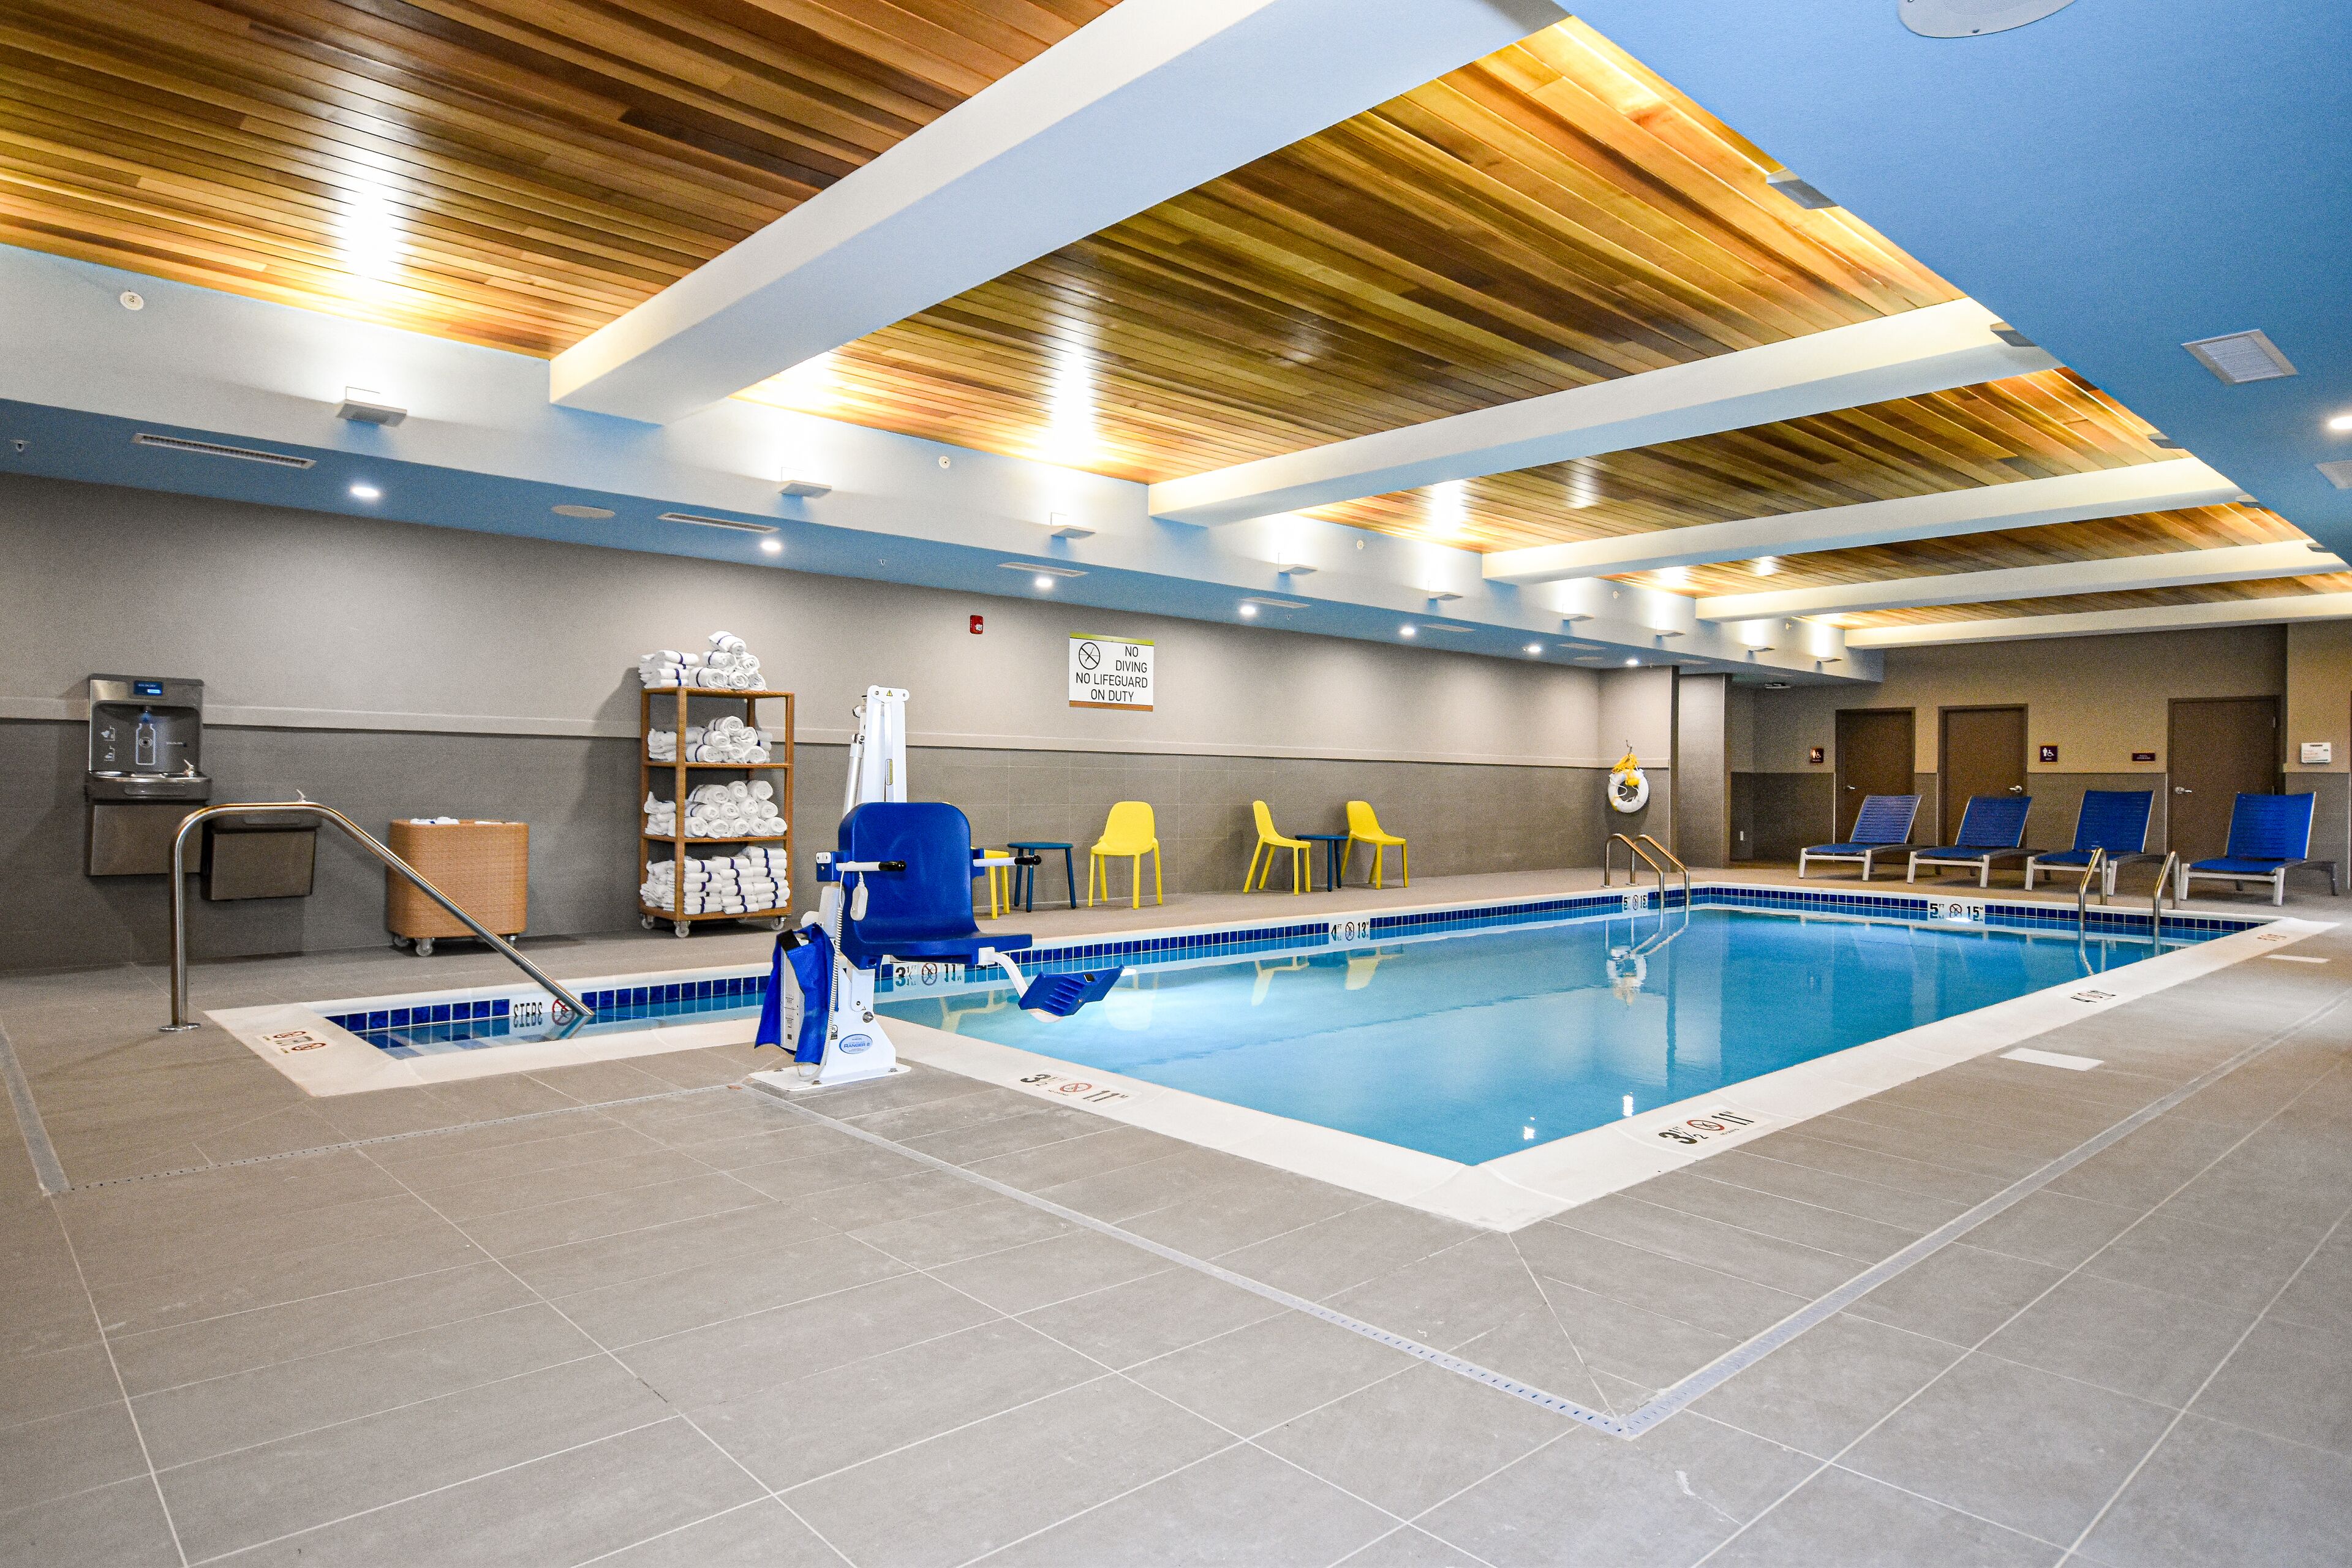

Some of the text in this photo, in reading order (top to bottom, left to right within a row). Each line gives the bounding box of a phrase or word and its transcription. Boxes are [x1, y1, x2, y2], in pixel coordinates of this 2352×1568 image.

[1125, 646, 1139, 657] NO
[1115, 660, 1147, 673] DIVING
[1076, 672, 1148, 688] NO LIFEGUARD
[1091, 688, 1134, 702] ON DUTY
[1658, 1131, 1698, 1145] 3
